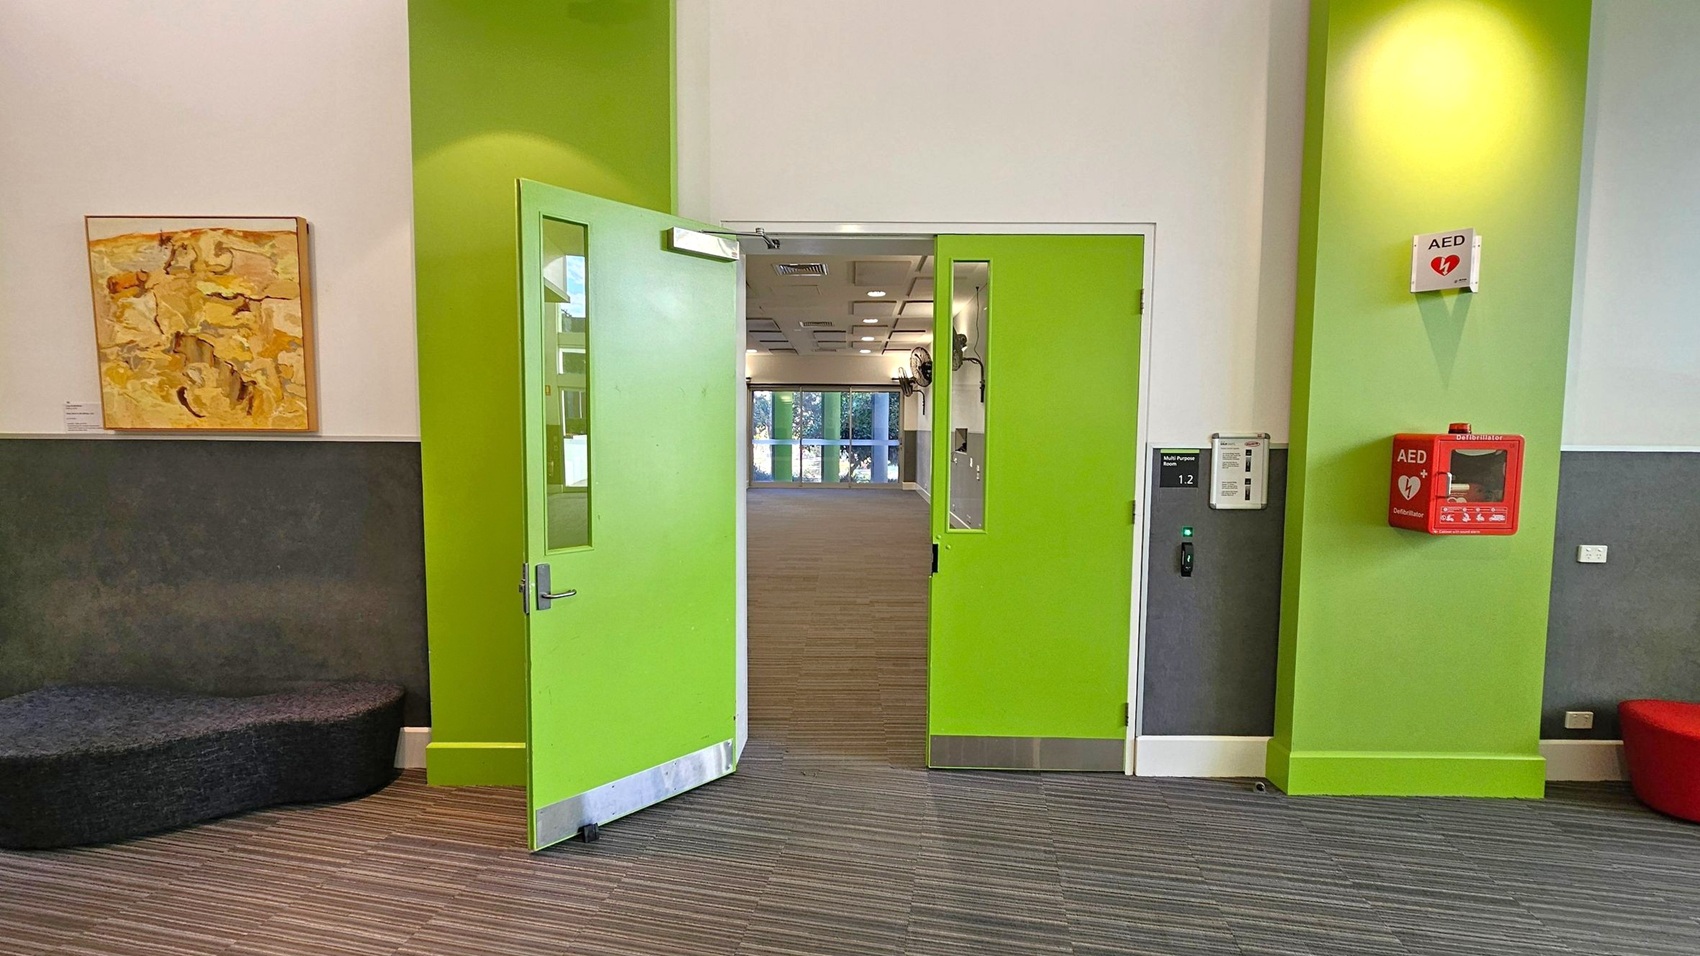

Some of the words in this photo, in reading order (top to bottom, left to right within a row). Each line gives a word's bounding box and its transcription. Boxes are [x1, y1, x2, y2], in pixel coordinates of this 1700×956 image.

[1428, 235, 1465, 250] AED
[1397, 449, 1427, 463] AED
[1178, 474, 1194, 485] 1.2
[1393, 507, 1424, 518] Defibrillator
